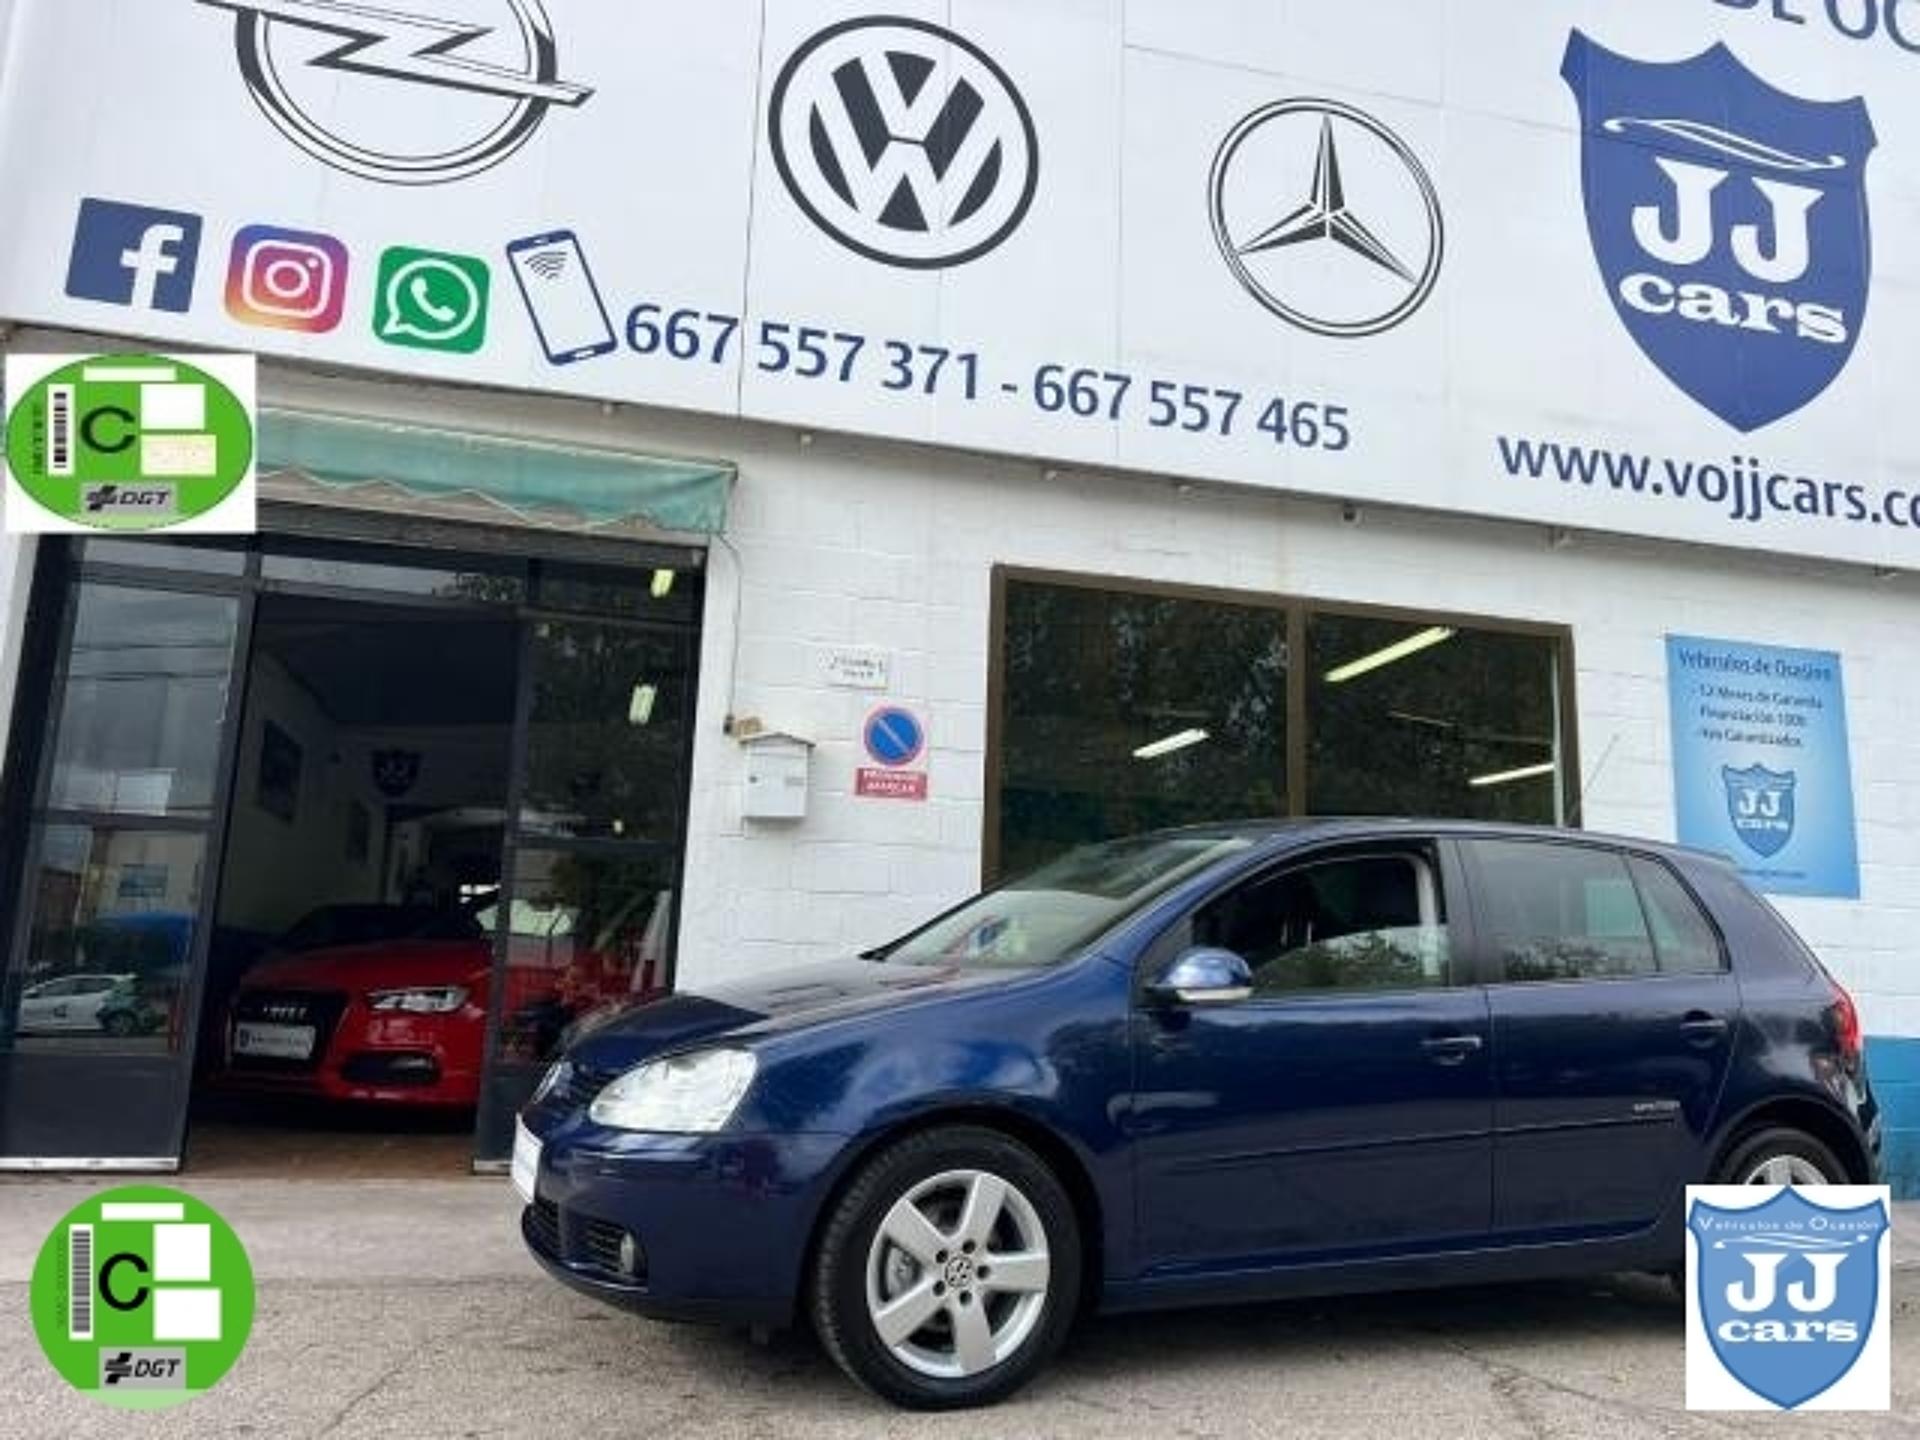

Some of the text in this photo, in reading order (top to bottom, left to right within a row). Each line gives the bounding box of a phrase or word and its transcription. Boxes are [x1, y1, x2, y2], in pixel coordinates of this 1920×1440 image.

[1631, 155, 1825, 283] JJ
[1620, 272, 1848, 344] cars
[625, 303, 739, 364] 667
[757, 321, 866, 382] 557
[882, 340, 979, 400] 371
[1033, 363, 1132, 421] 667
[1148, 381, 1242, 436] 557
[1256, 397, 1350, 450] 465
[1738, 788, 1782, 818] JJ
